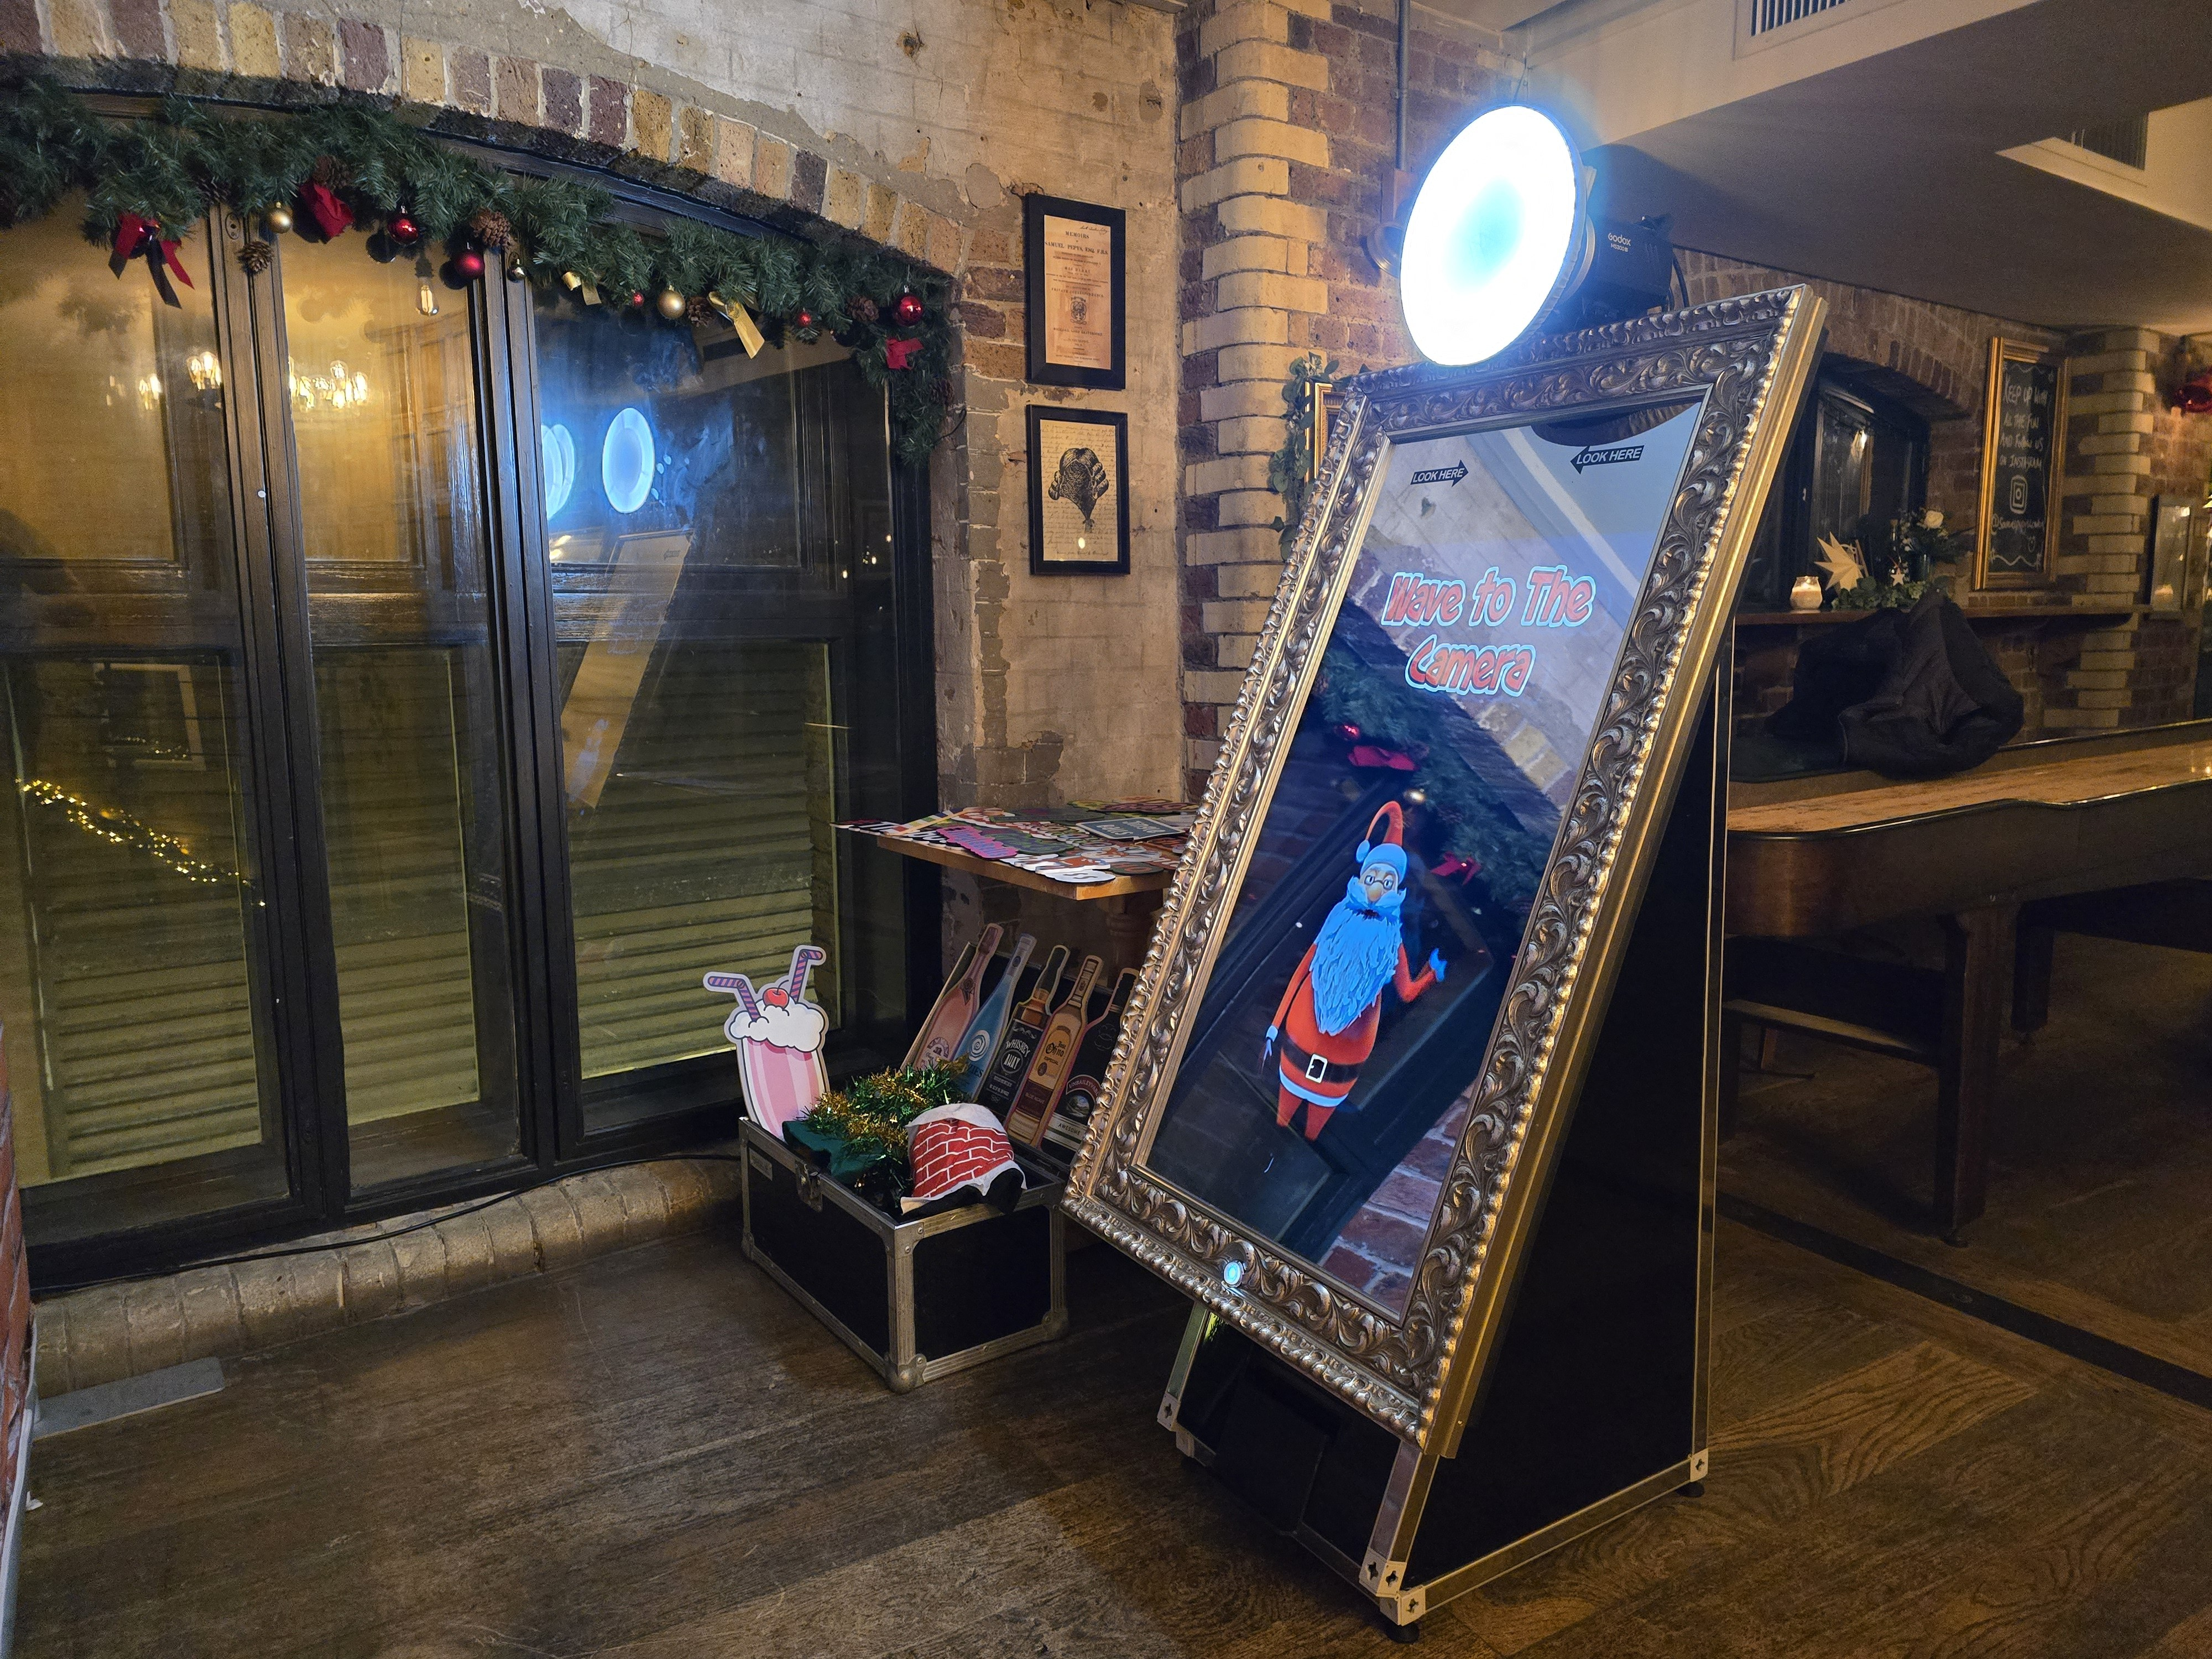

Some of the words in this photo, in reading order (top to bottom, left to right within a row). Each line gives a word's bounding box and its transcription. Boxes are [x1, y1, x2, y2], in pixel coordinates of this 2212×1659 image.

[1608, 232, 1631, 246] Godox
[1576, 451, 1608, 465] LOOK
[1609, 447, 1642, 461] HERE
[1412, 471, 1438, 483] LOOK
[1438, 467, 1465, 480] HERE
[1381, 572, 1466, 626] Wave
[1469, 566, 1516, 627] to
[1521, 565, 1596, 627] The
[1405, 634, 1536, 697] Camera
[1005, 1039, 1031, 1057] WHISKEY
[1003, 1053, 1021, 1070] AWAY
[1069, 1080, 1099, 1097] UNBAILEYVABL
[1057, 1123, 1081, 1135] AWESOME
